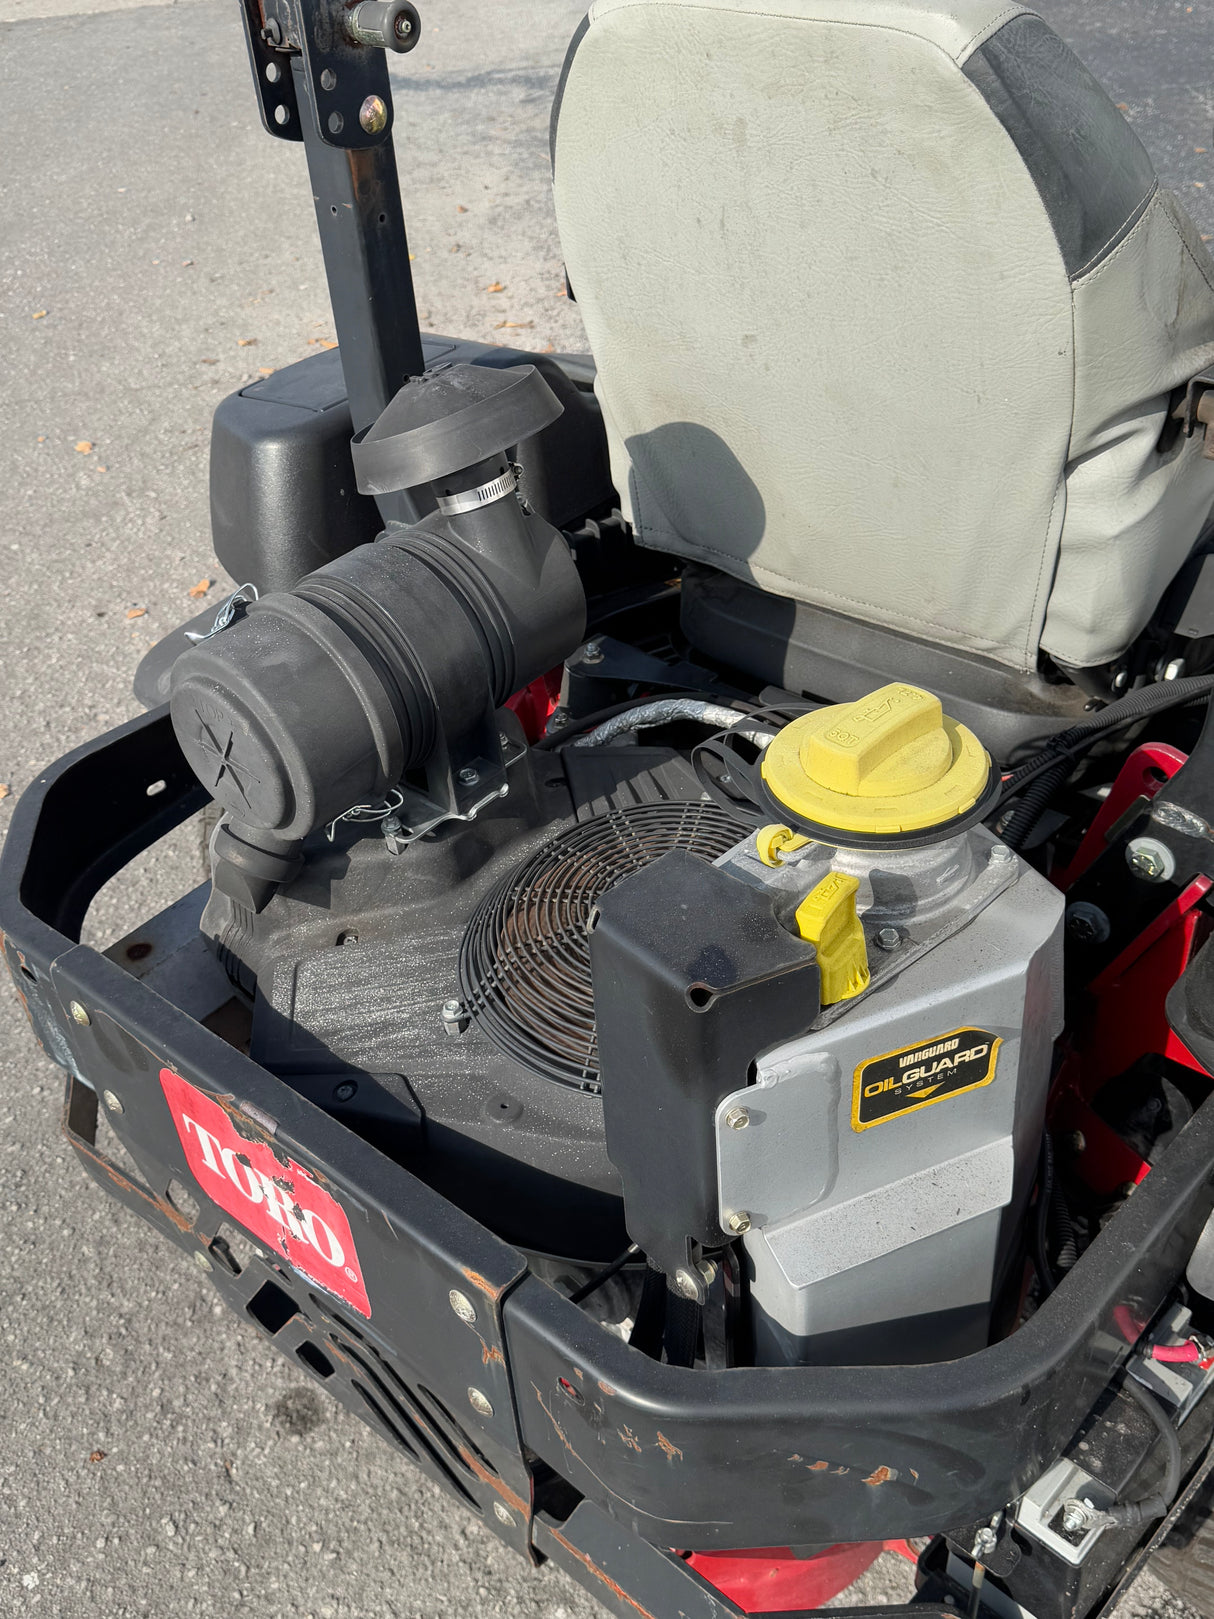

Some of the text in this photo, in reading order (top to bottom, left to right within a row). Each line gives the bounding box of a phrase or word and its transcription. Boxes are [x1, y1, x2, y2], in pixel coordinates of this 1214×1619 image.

[864, 1045, 988, 1098] OILGUARD
[899, 1038, 960, 1068] VANGUARD
[894, 1069, 957, 1095] SYSTEM
[183, 1114, 345, 1267] TORO
